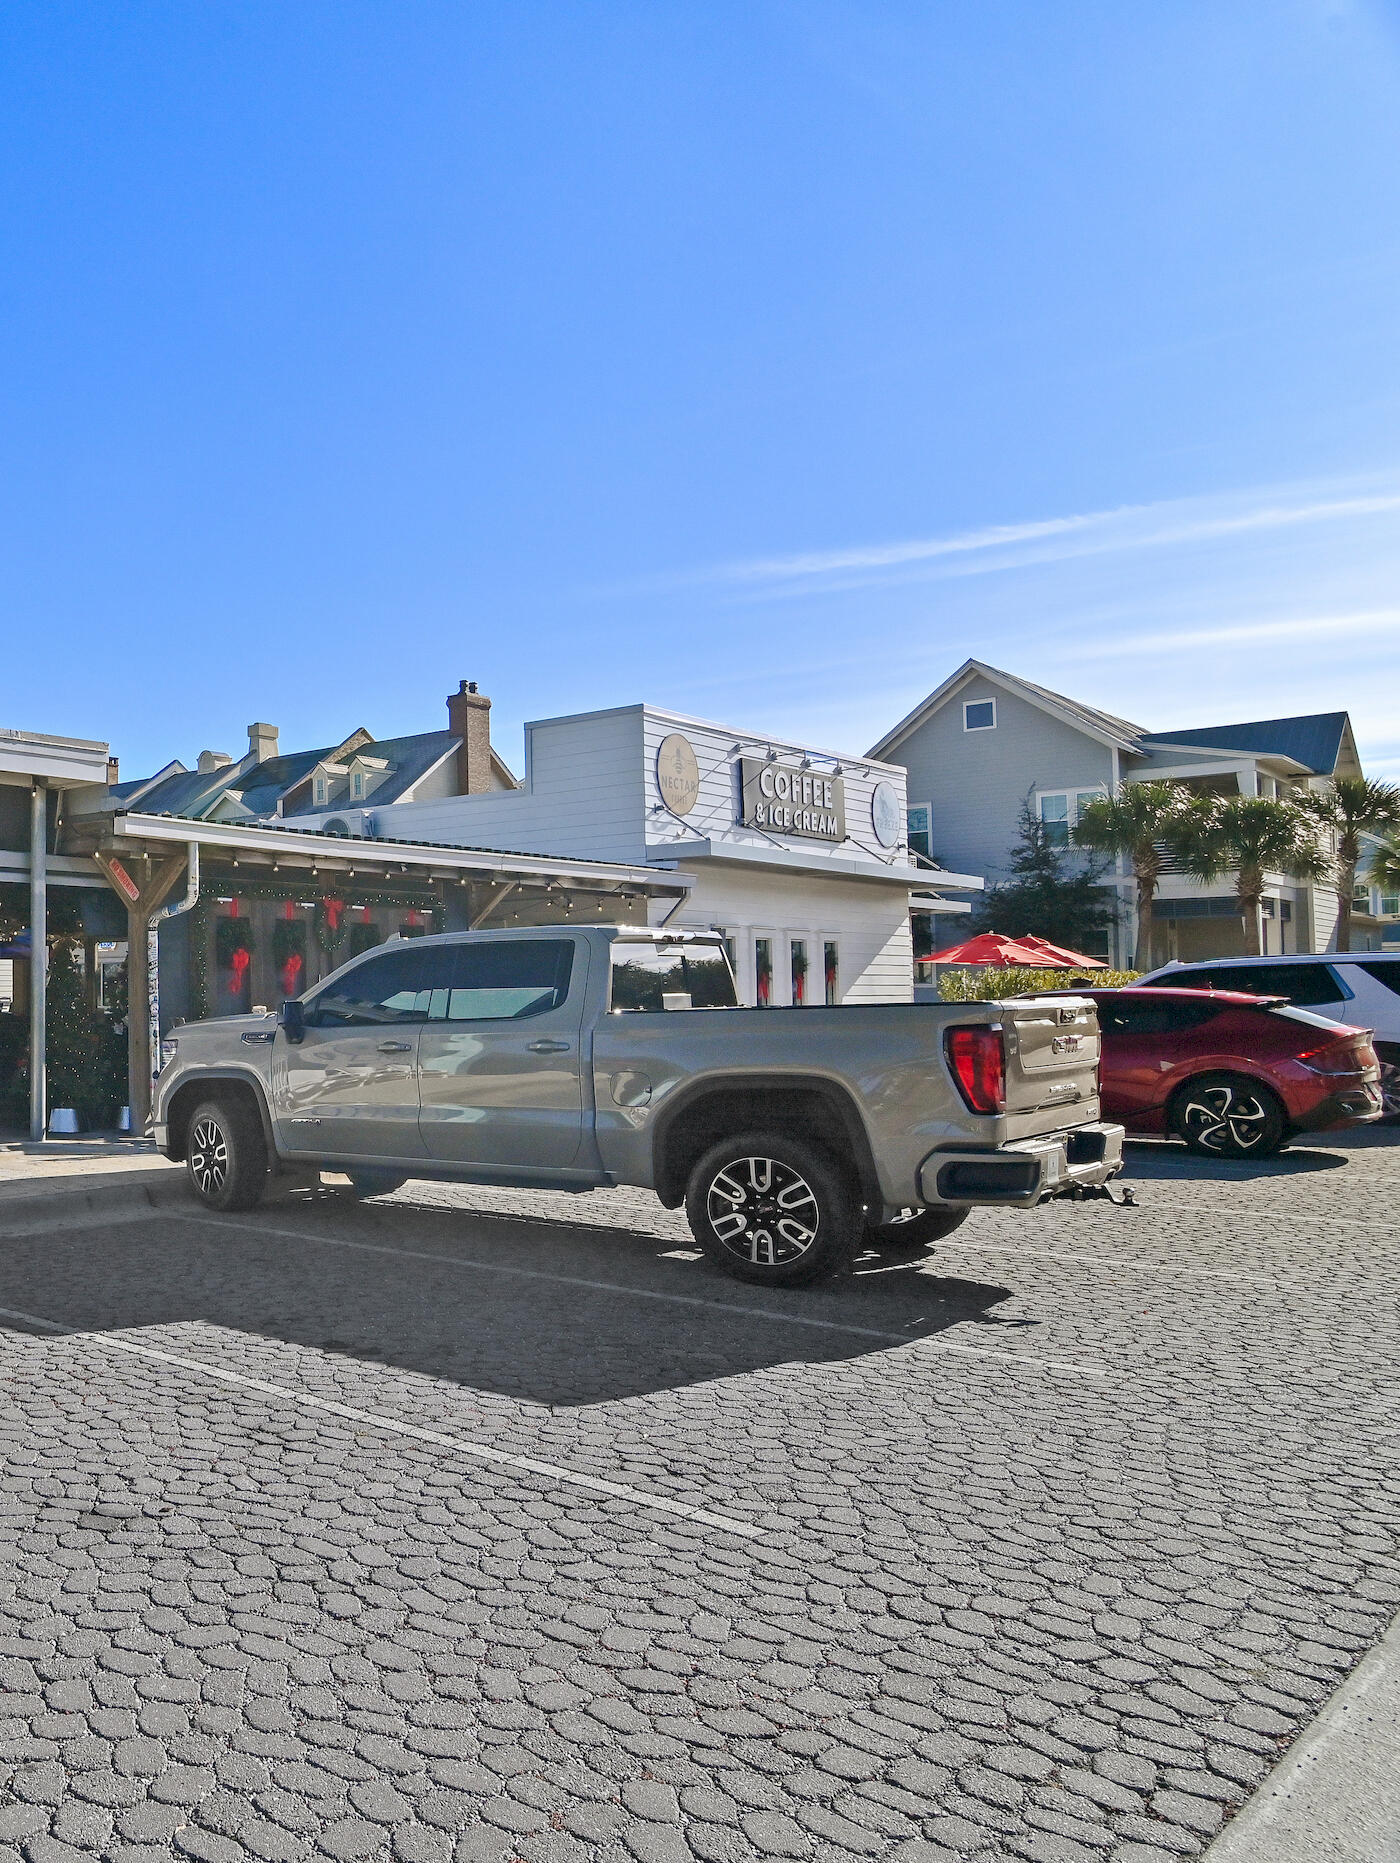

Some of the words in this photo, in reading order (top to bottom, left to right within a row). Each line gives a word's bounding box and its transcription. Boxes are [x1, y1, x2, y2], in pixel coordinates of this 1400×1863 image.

[661, 775, 696, 793] NECTAR
[760, 768, 833, 809] COFFEE
[755, 802, 765, 823] &
[769, 804, 790, 827] ICE
[793, 809, 838, 835] CREAM
